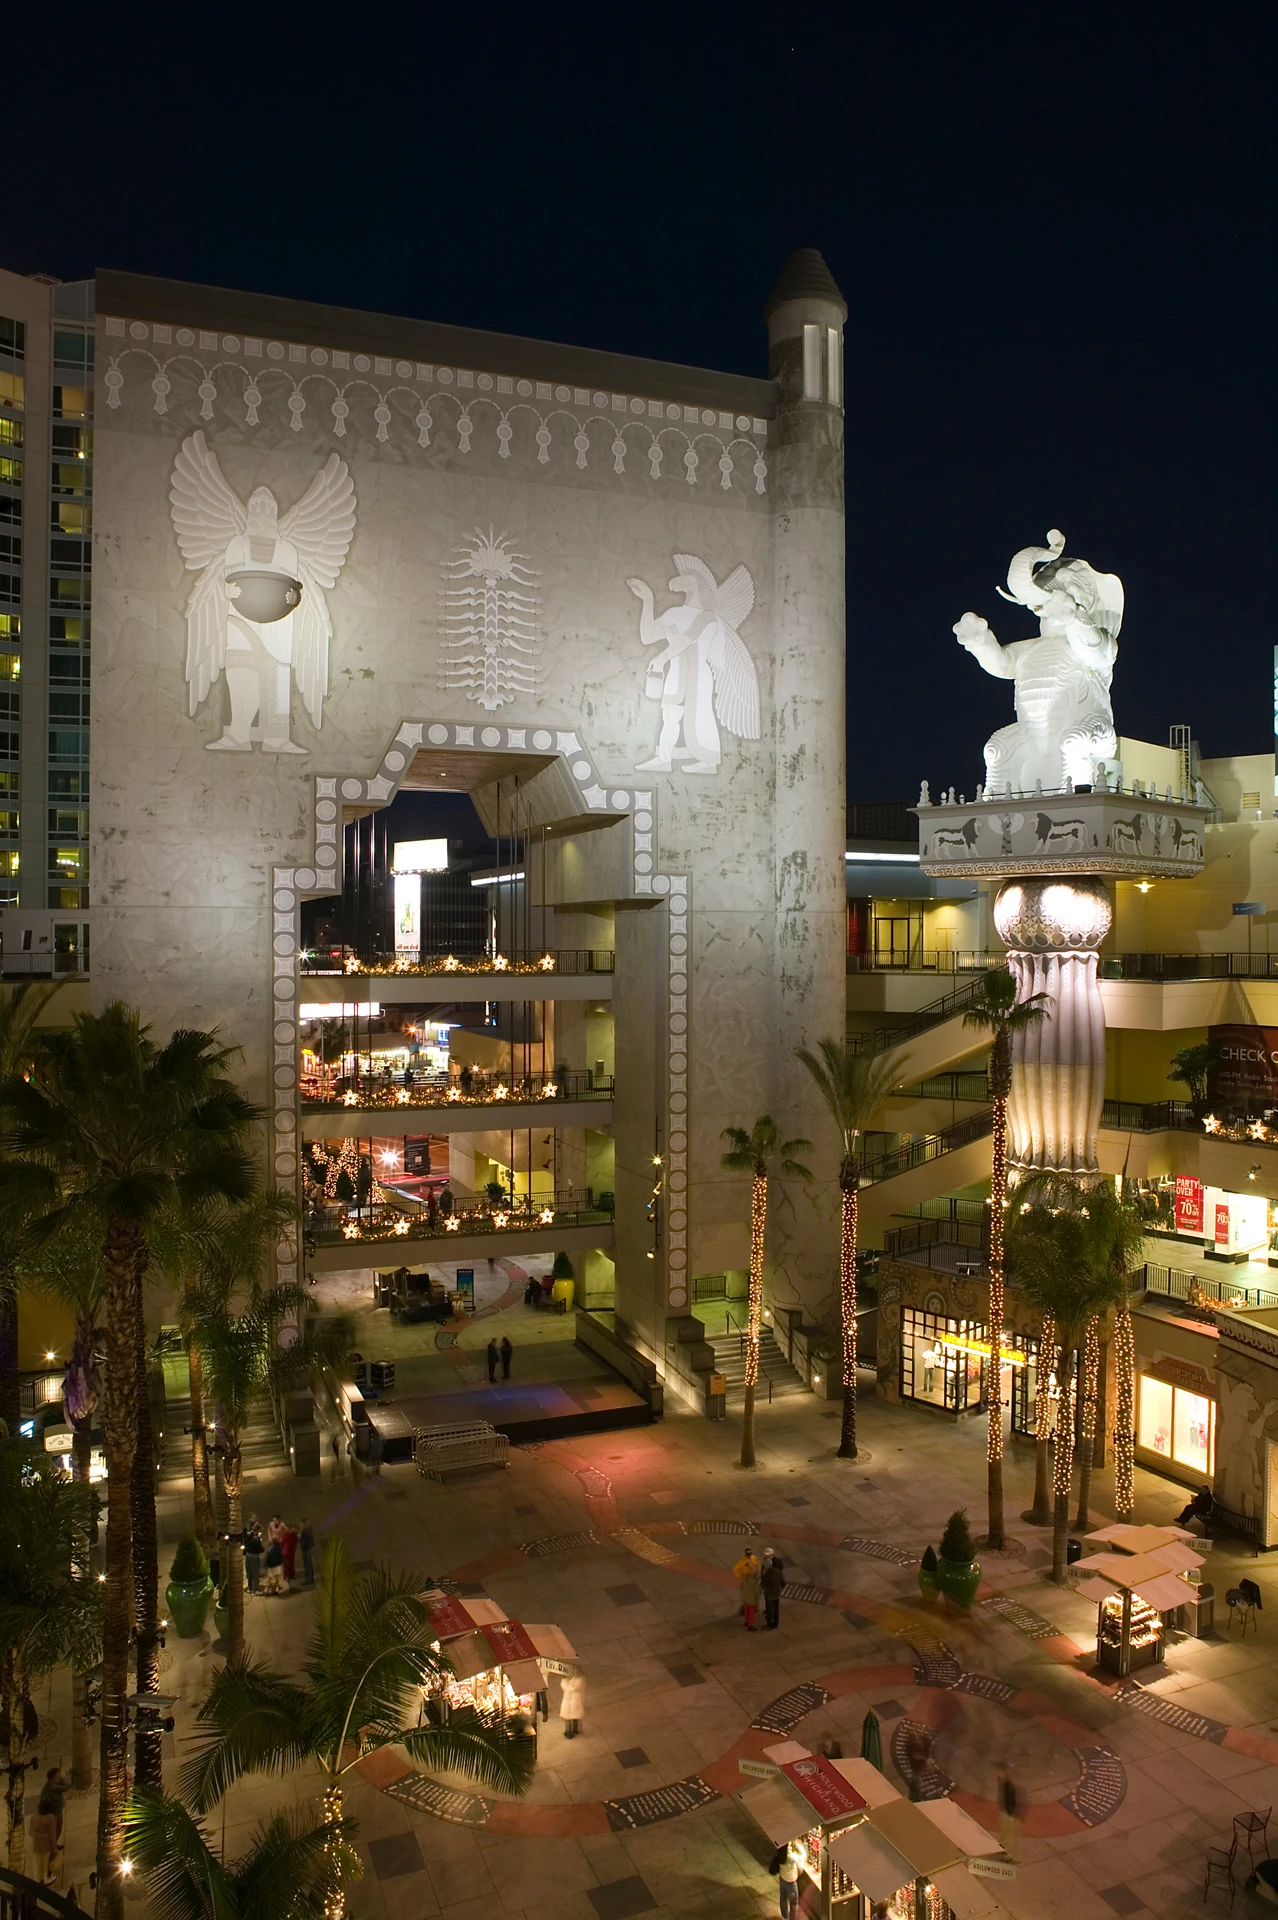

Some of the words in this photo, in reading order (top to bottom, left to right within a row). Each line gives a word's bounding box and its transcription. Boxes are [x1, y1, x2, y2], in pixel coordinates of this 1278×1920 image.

[1220, 1047, 1267, 1063] CHECK
[1176, 1187, 1194, 1197] OVER
[817, 1772, 854, 1808] HOLLYWOOD
